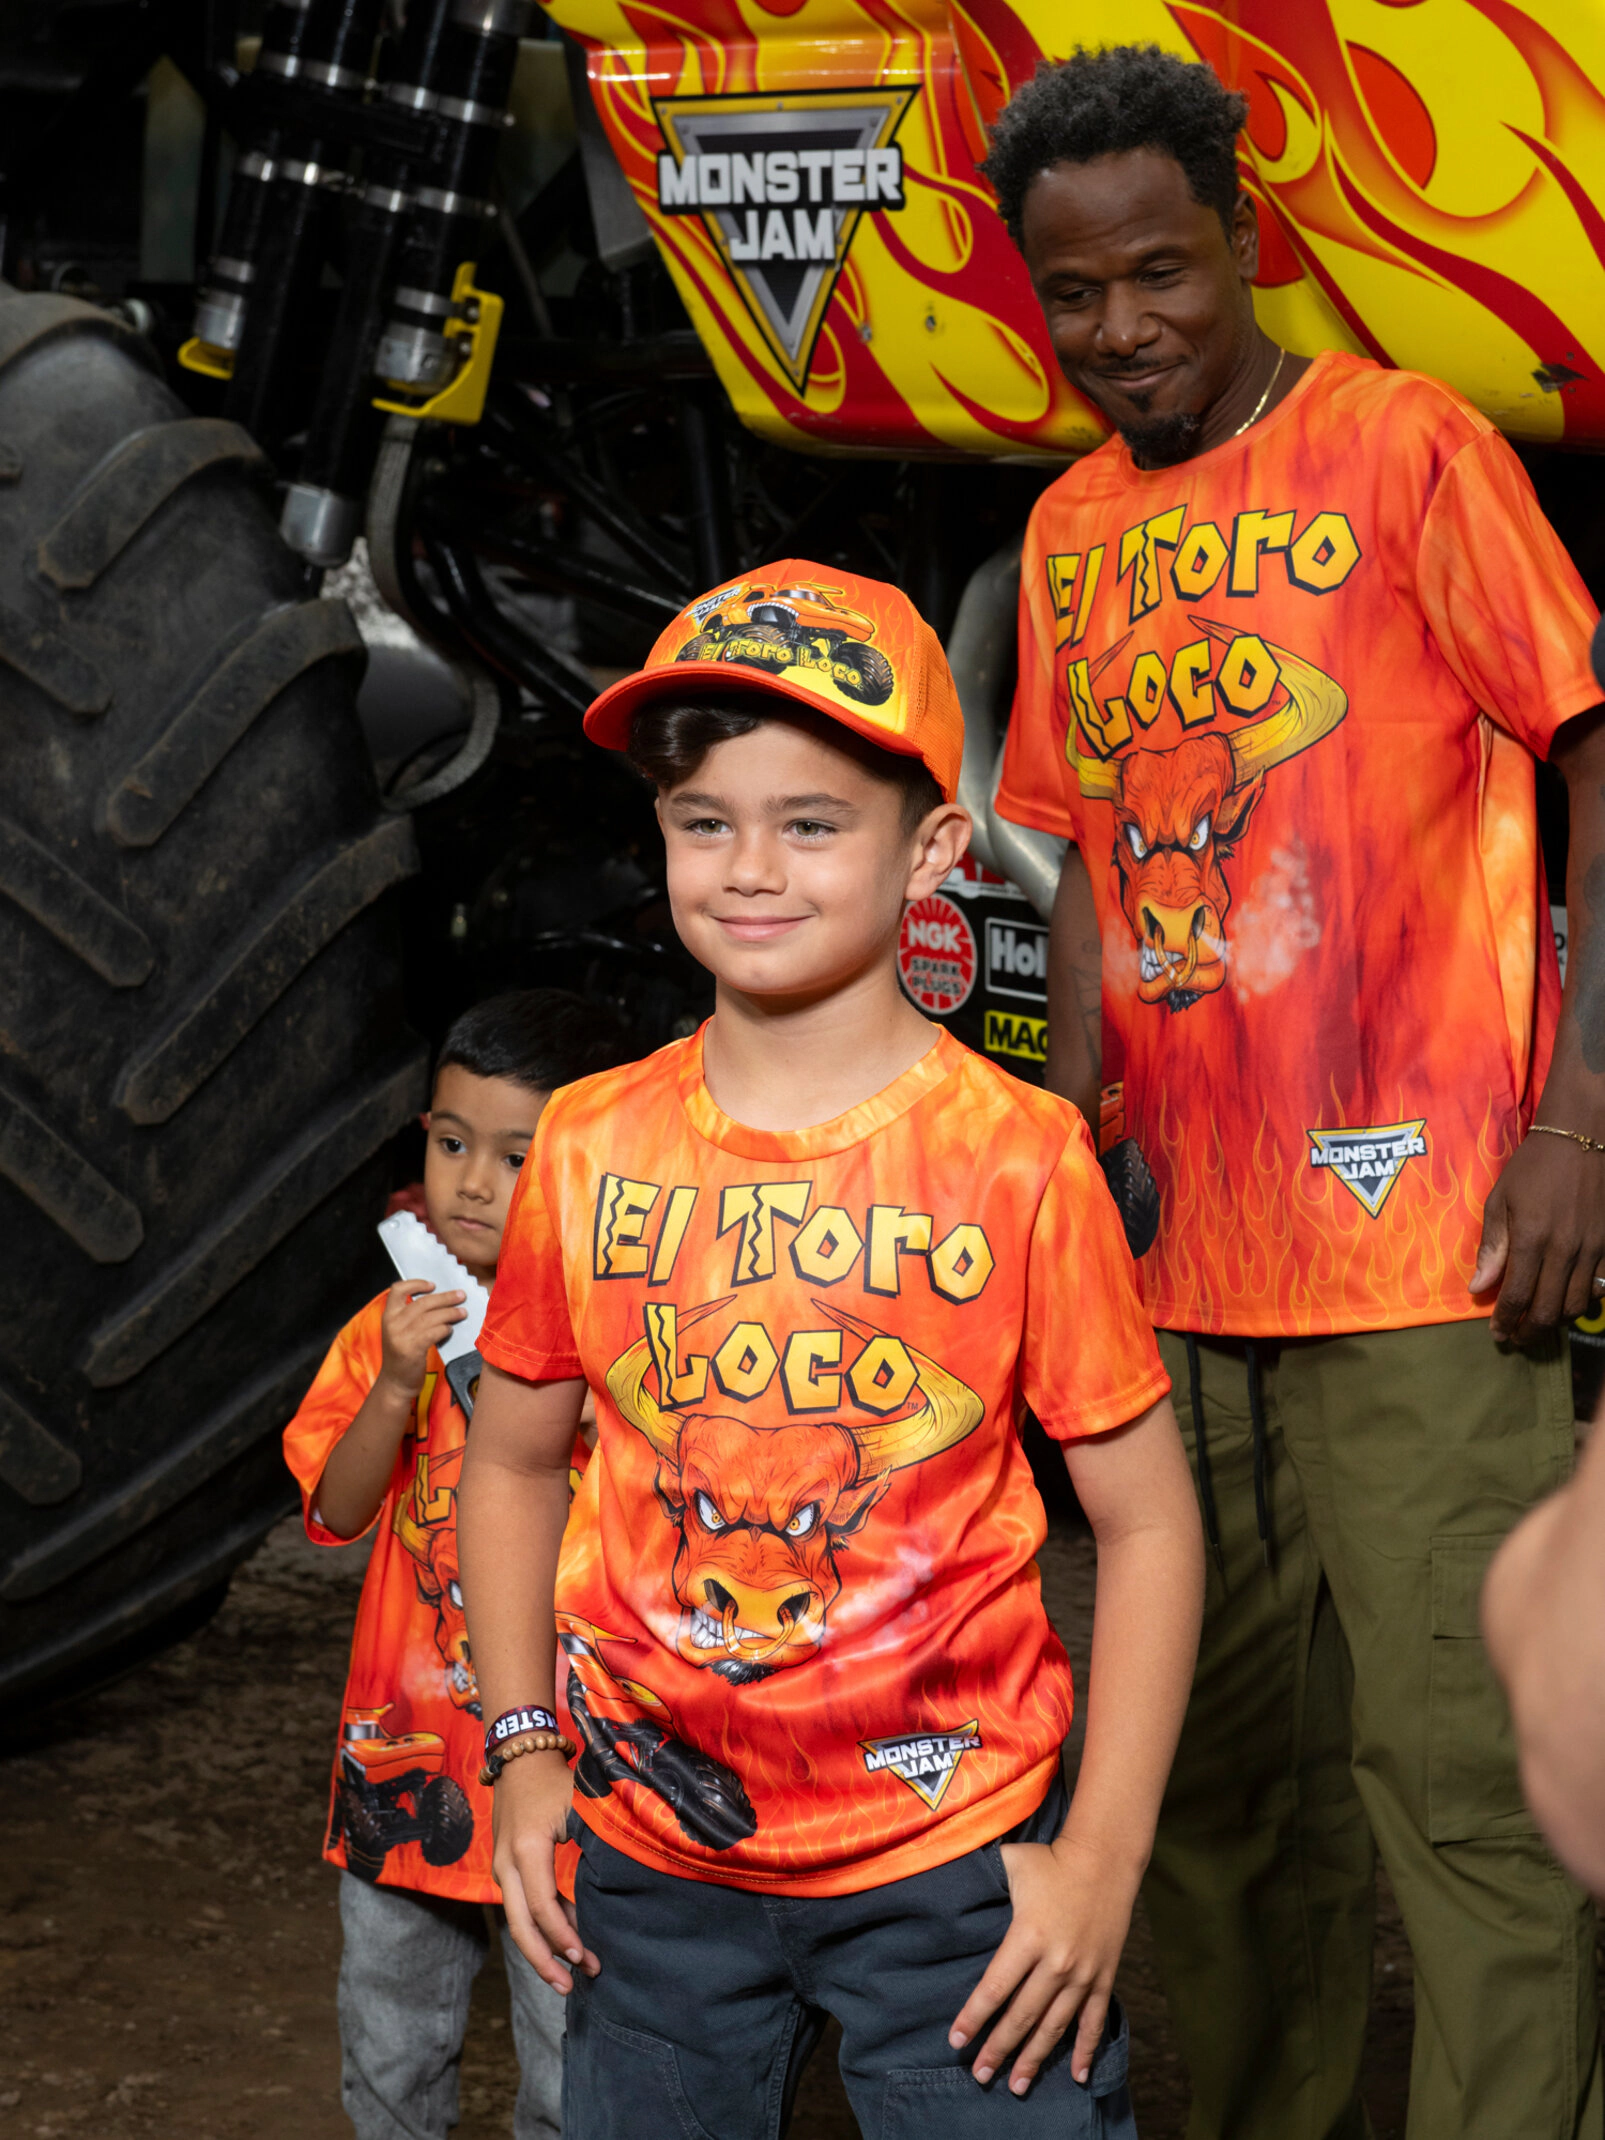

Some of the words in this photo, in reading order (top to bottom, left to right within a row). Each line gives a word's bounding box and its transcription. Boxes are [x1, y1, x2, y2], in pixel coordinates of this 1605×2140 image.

[658, 147, 902, 204] MONSTER
[730, 209, 836, 260] JAM
[1046, 543, 1106, 655] El
[1116, 503, 1362, 626] Toro
[699, 642, 724, 661] El
[729, 639, 793, 664] Toro
[907, 920, 962, 954] NGK
[991, 927, 1048, 979] Hol
[911, 957, 961, 977] SPARK
[912, 976, 961, 995] PLUGS
[1310, 1136, 1426, 1165] MONSTER
[1342, 1160, 1395, 1180] JAM
[593, 1172, 699, 1288] El
[716, 1180, 996, 1306] Toro
[494, 1709, 559, 1740] NSTER
[864, 1735, 982, 1771] MONSTER
[902, 1752, 954, 1779] JAM
